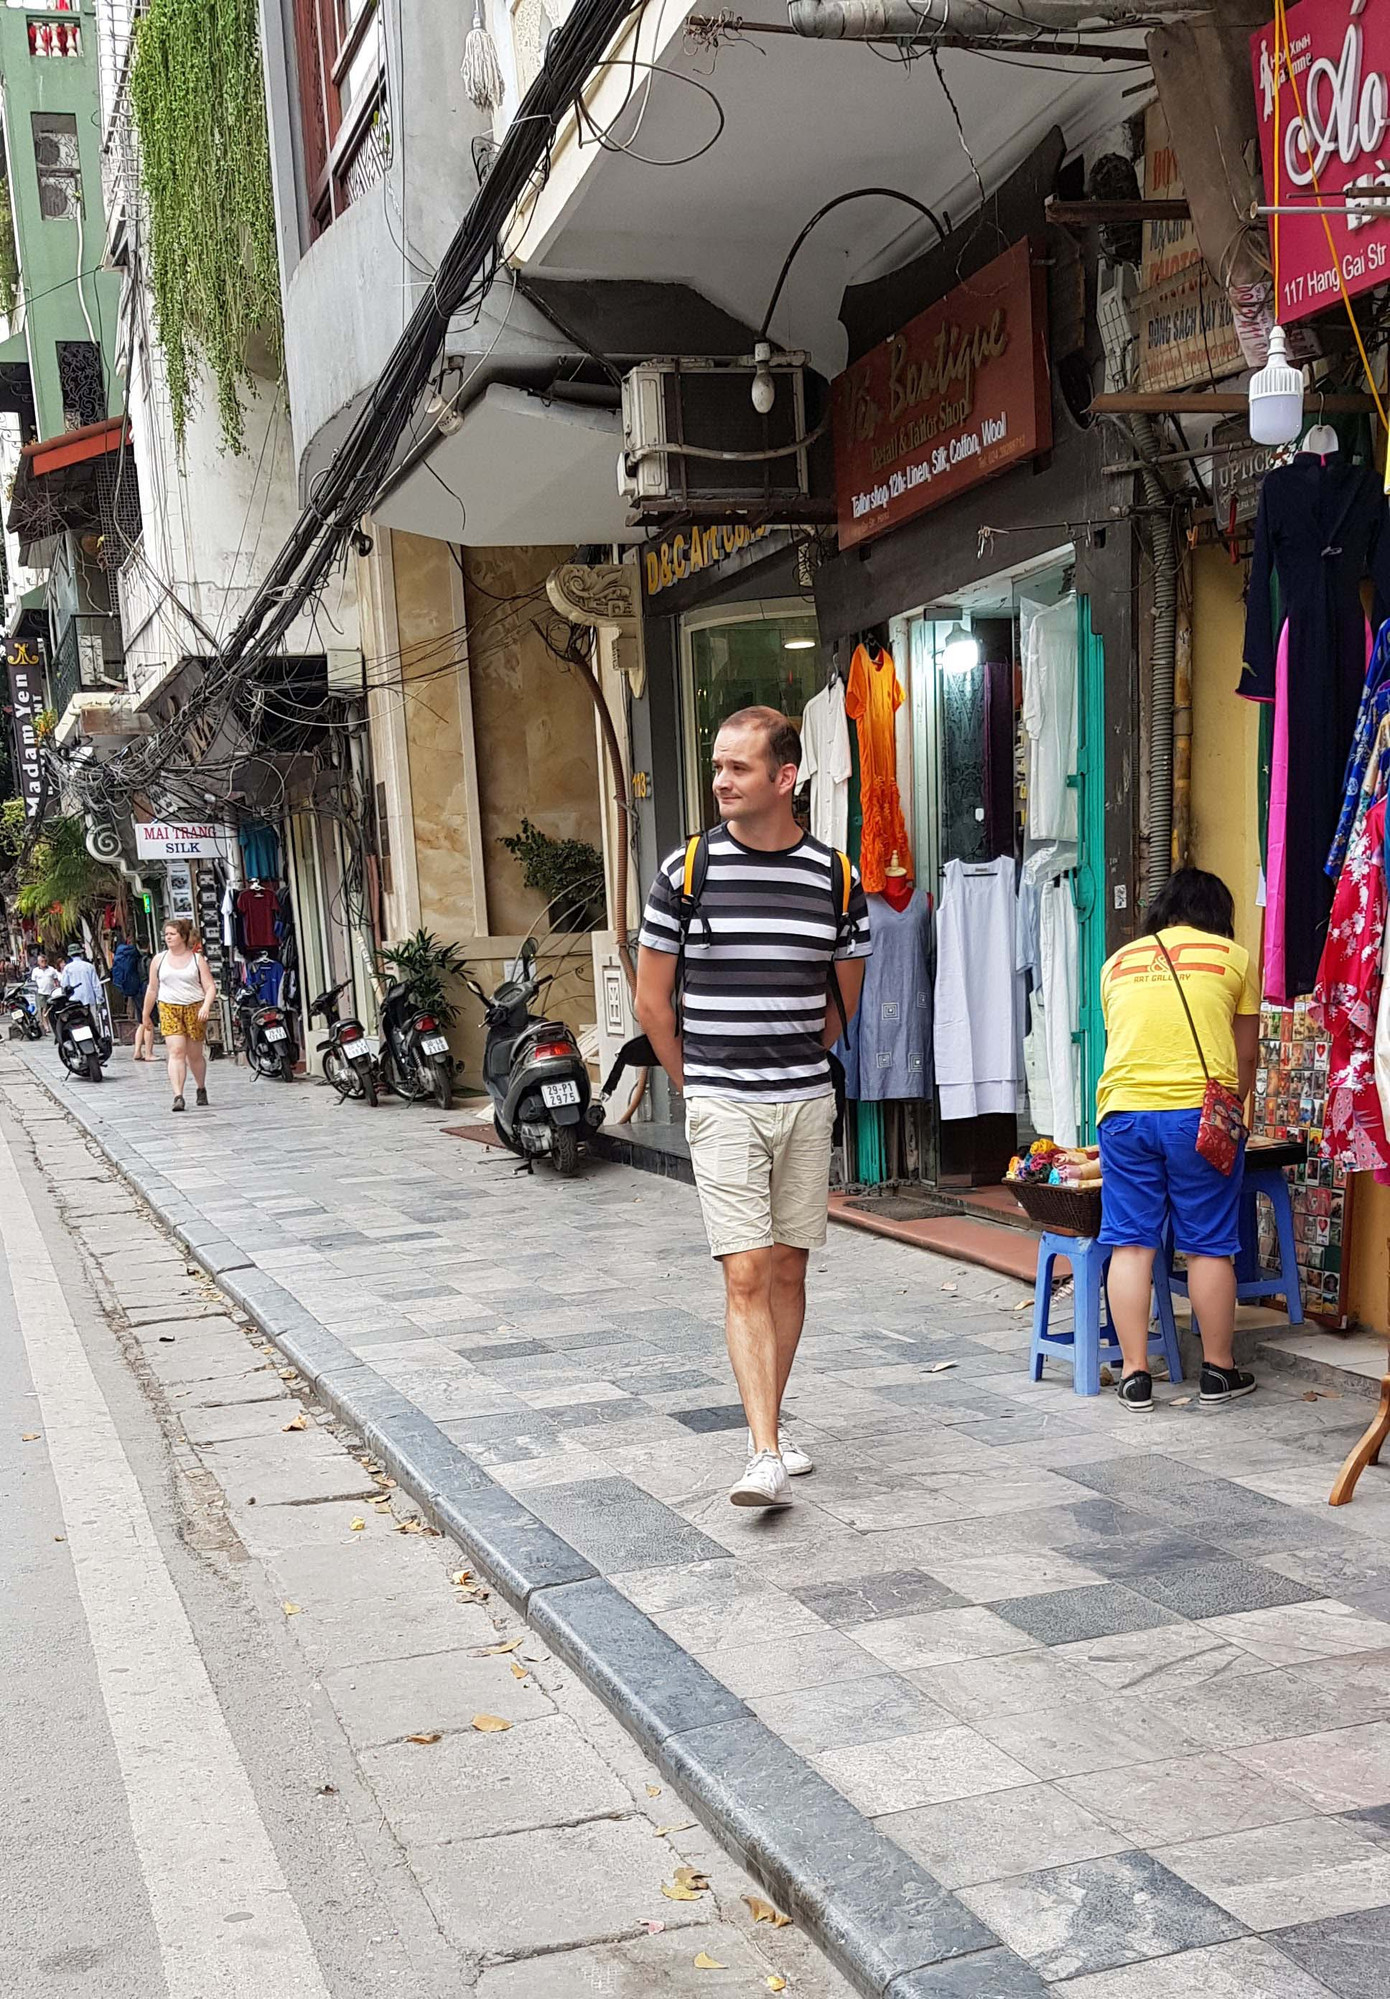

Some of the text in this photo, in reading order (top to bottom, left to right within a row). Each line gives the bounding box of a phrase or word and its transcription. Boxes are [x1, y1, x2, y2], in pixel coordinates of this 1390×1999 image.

[1290, 33, 1311, 57] XINH
[1284, 242, 1387, 306] 117 Hang Gai Str
[889, 308, 1007, 423] Boutique
[908, 415, 938, 450] Tailor
[938, 399, 968, 431] Shop
[851, 492, 871, 519] Tailor
[870, 484, 889, 509] shop
[949, 433, 981, 464] Cotton,
[981, 411, 1007, 447] Wool
[646, 534, 688, 595] D&C
[690, 525, 721, 574] Art
[14, 673, 42, 818] Madam Yen
[632, 771, 647, 798] 113
[143, 826, 216, 841] MAI TRANG
[166, 842, 200, 853] SILK
[1134, 974, 1191, 983] ART GALLRY
[547, 1081, 574, 1096] 29-P1
[550, 1091, 577, 1106] 2975
